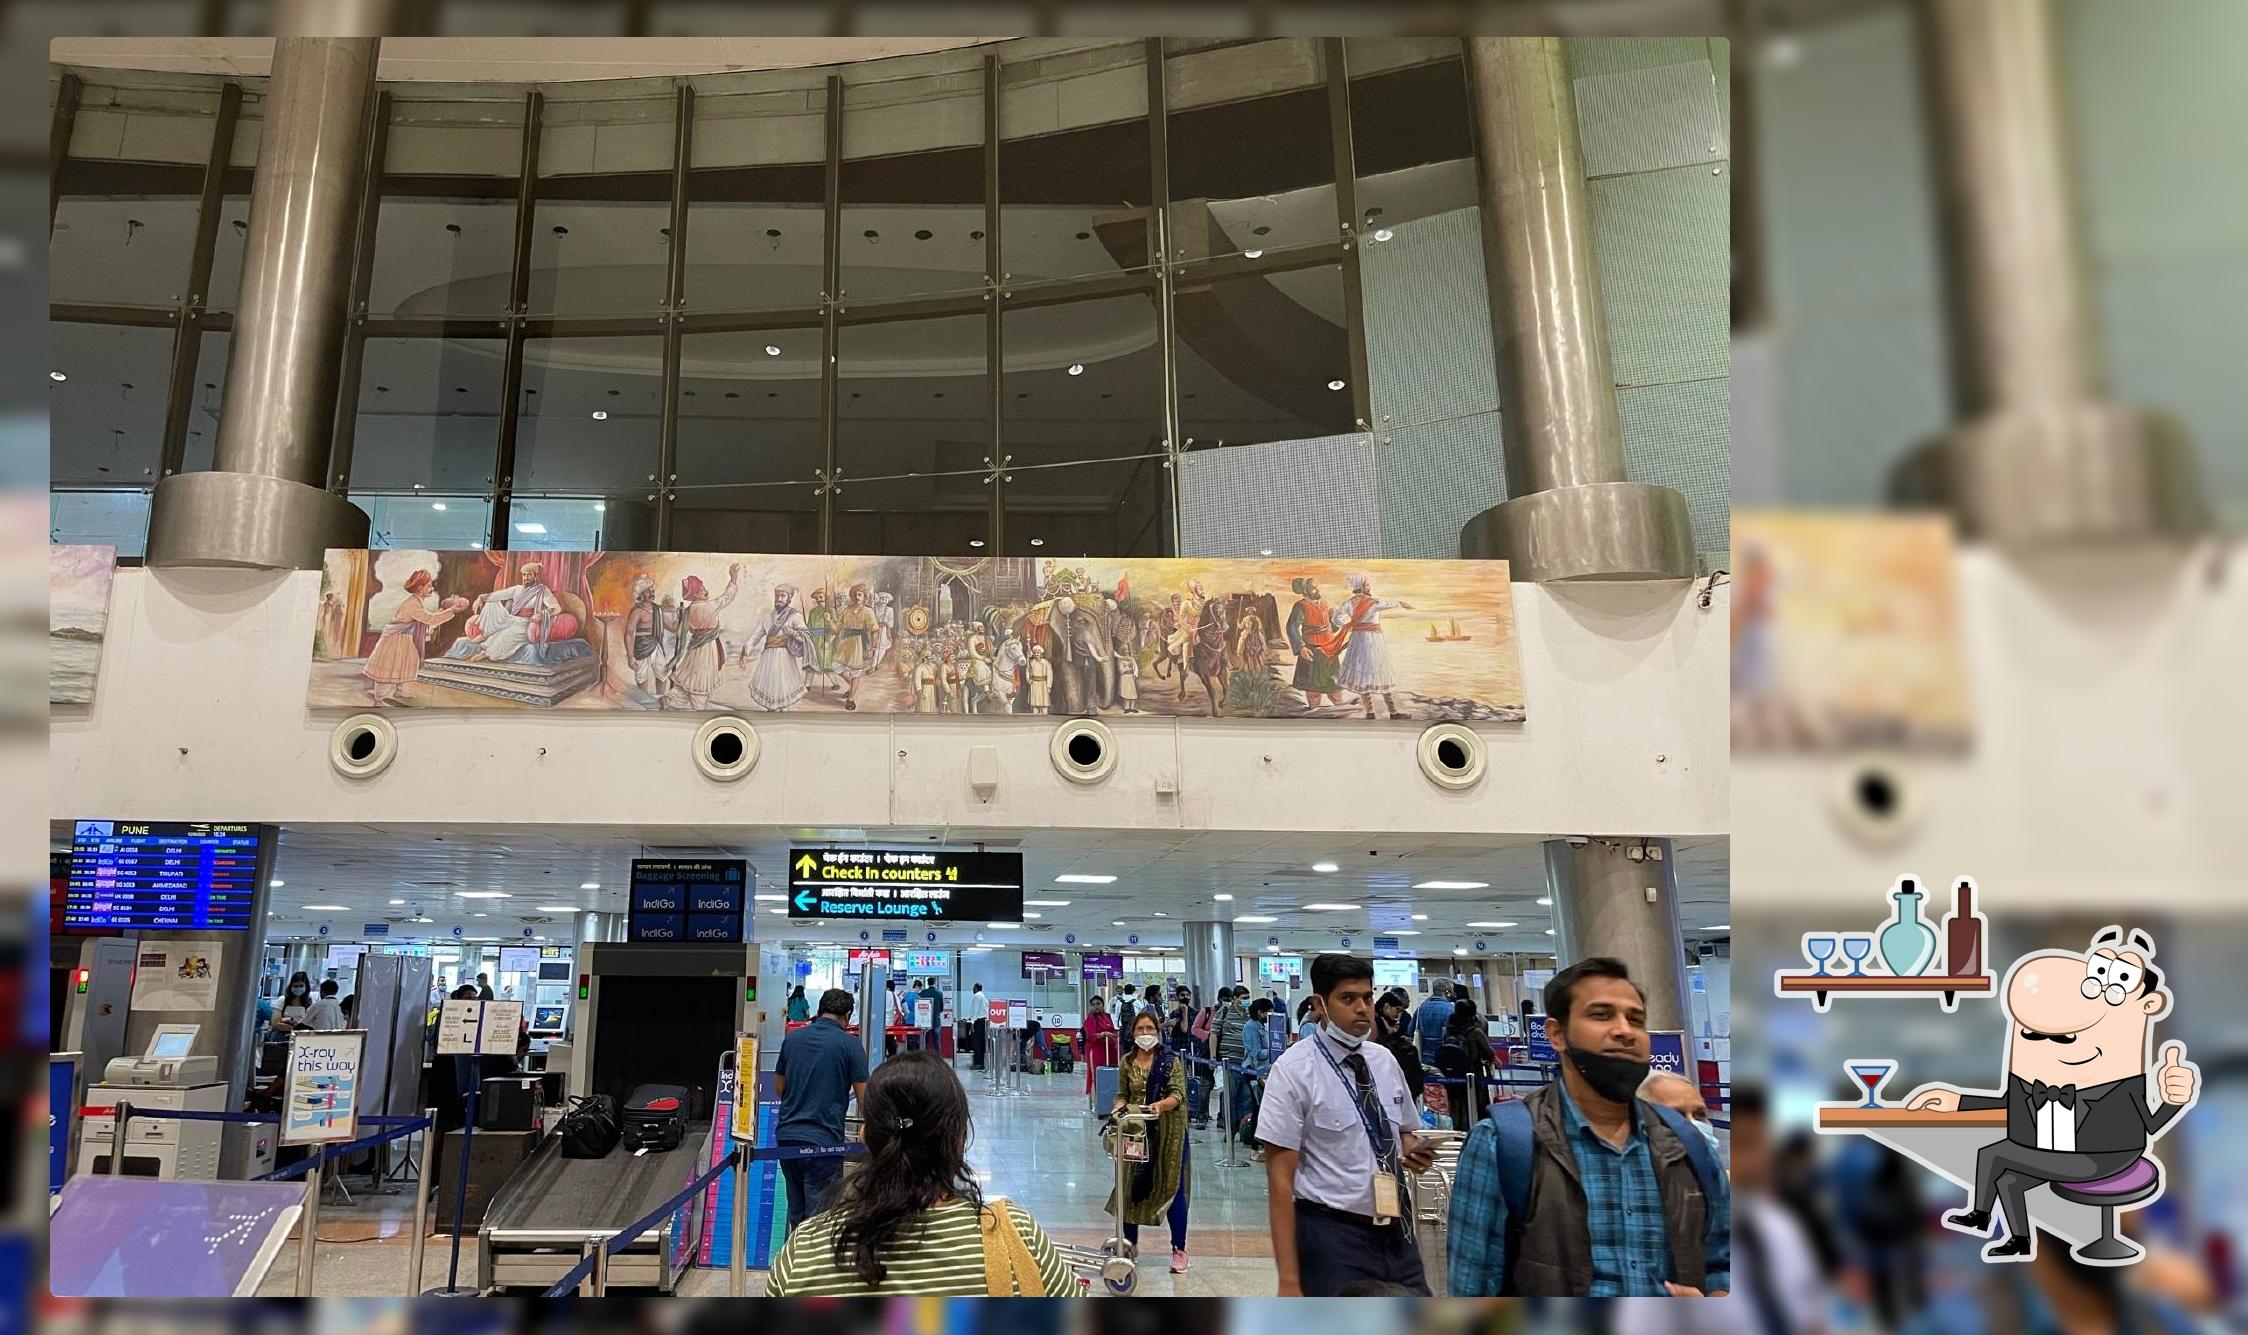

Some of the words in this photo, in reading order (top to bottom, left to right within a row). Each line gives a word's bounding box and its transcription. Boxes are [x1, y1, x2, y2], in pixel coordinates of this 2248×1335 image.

[122, 826, 149, 834] PUNE
[636, 872, 674, 881] Baggage
[676, 872, 720, 881] Screening
[822, 866, 863, 880] Check
[866, 867, 879, 880] In
[882, 868, 942, 881] counters
[643, 899, 675, 909] IndiGo
[698, 899, 730, 909] IndiGo
[821, 901, 873, 914] Reserve
[877, 902, 927, 917] Lounge
[641, 928, 673, 938] IndiGo
[697, 929, 728, 938] IndiGo
[299, 1046, 336, 1061] X-ray
[1649, 1051, 1680, 1066] eady
[298, 1059, 322, 1072] this
[326, 1061, 356, 1074] way
